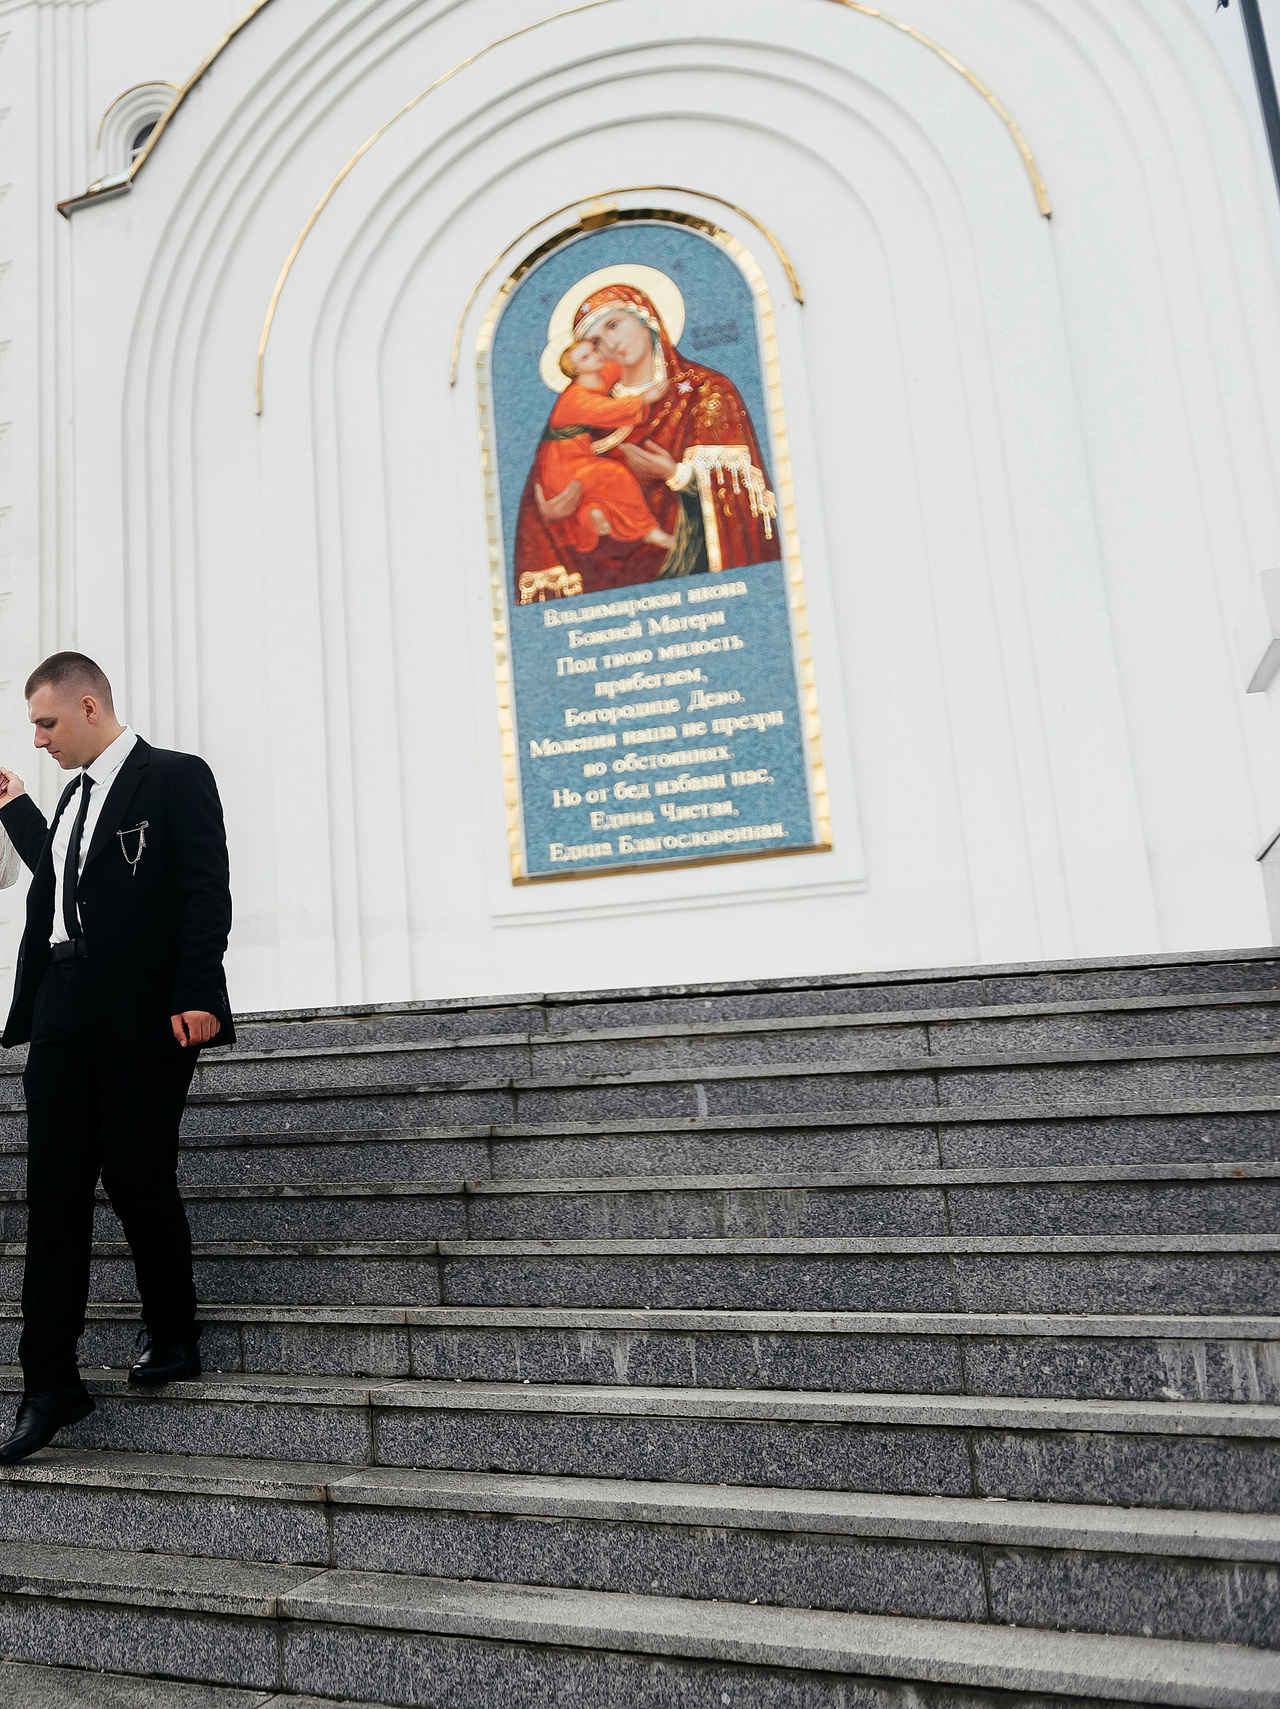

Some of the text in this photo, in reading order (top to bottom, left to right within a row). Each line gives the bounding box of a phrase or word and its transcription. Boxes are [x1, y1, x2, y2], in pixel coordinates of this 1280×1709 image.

[543, 581, 748, 629] Владимирская икона
[568, 610, 727, 650] Божией Матери
[556, 634, 744, 676] Под твою милость
[565, 698, 682, 729] Богородице
[530, 711, 784, 758] Моления наша не презри
[583, 762, 607, 777] во
[552, 788, 582, 808] Но
[585, 789, 610, 803] от
[613, 781, 651, 800] бед
[655, 773, 726, 796] избави
[590, 811, 655, 830] Едина
[549, 842, 615, 864] Едина
